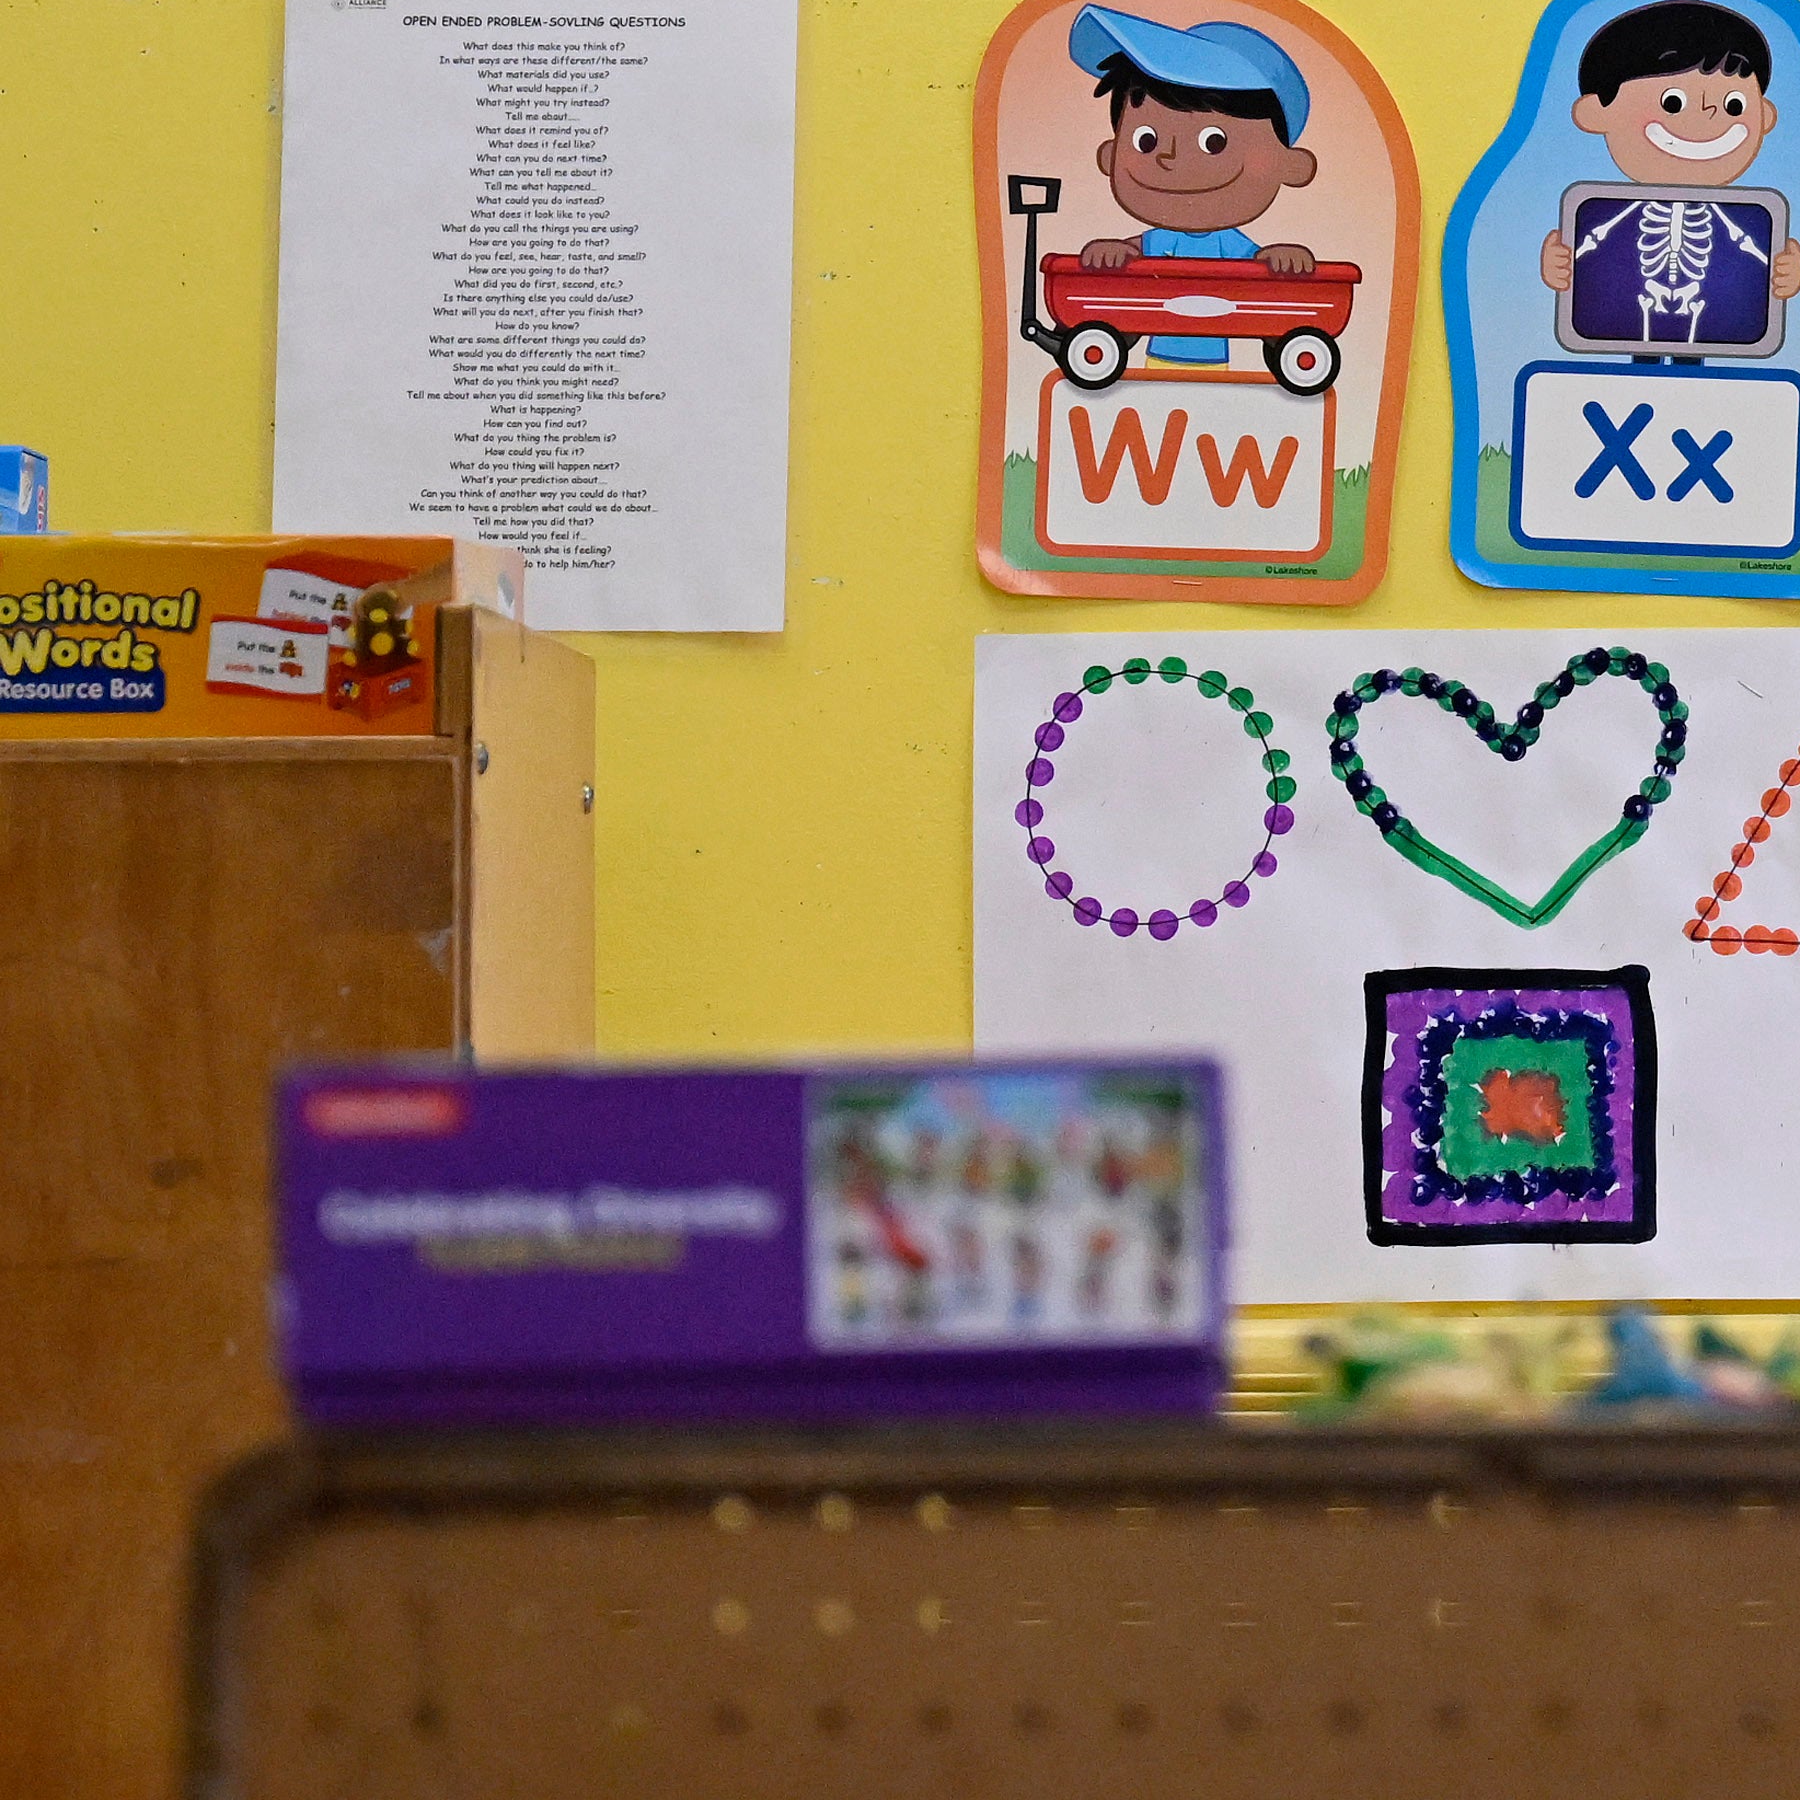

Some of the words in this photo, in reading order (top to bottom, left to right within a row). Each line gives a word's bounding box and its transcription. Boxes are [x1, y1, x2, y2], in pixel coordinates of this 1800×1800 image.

[402, 15, 437, 27] OPEN
[441, 15, 483, 27] ENDED
[487, 16, 605, 28] PROBLEM-SOVLING
[609, 16, 686, 28] QUESTIONS
[463, 41, 489, 51] What
[491, 41, 513, 51] does
[517, 42, 535, 51] this
[537, 42, 561, 51] make
[563, 44, 580, 54] you
[583, 42, 607, 51] think
[609, 42, 626, 51] of?
[477, 70, 503, 79] What
[506, 69, 550, 79] materials
[552, 70, 568, 79] did
[570, 72, 586, 81] you
[588, 70, 610, 79] use?
[469, 167, 495, 177] What
[516, 170, 533, 179] you
[536, 167, 552, 177] tell
[570, 168, 597, 177] about
[600, 168, 613, 177] it?
[441, 223, 467, 233] What
[469, 224, 481, 233] do
[483, 226, 500, 235] you
[503, 223, 519, 233] call
[522, 223, 538, 233] the
[541, 224, 570, 236] things
[572, 226, 589, 235] you
[609, 224, 639, 236] using?
[429, 335, 455, 344] What
[503, 335, 548, 344] different
[551, 335, 580, 347] things
[583, 338, 600, 347] you
[602, 335, 627, 345] could
[629, 335, 646, 344] do?
[406, 390, 424, 399] Tell
[443, 390, 470, 400] about
[473, 391, 497, 400] when
[499, 393, 516, 402] you
[518, 391, 533, 400] did
[536, 391, 585, 403] something
[587, 390, 604, 400] like
[607, 391, 625, 400] this
[628, 391, 666, 400] before?
[484, 447, 505, 456] How
[508, 447, 533, 456] could
[535, 450, 552, 458] you
[555, 446, 569, 457] fix
[571, 447, 585, 456] it?
[1068, 406, 1299, 509] Ww
[1574, 401, 1734, 503] Xx
[420, 489, 438, 498] Can
[440, 491, 457, 500] you
[459, 489, 484, 498] think
[486, 489, 496, 498] of
[499, 489, 537, 498] another
[540, 492, 558, 501] way
[560, 492, 577, 500] you
[579, 489, 604, 499] could
[607, 489, 618, 498] do
[622, 489, 647, 499] that?
[0, 580, 197, 630] ositional
[0, 628, 156, 676] Words
[0, 678, 104, 700] Resource
[110, 678, 154, 700] Box
